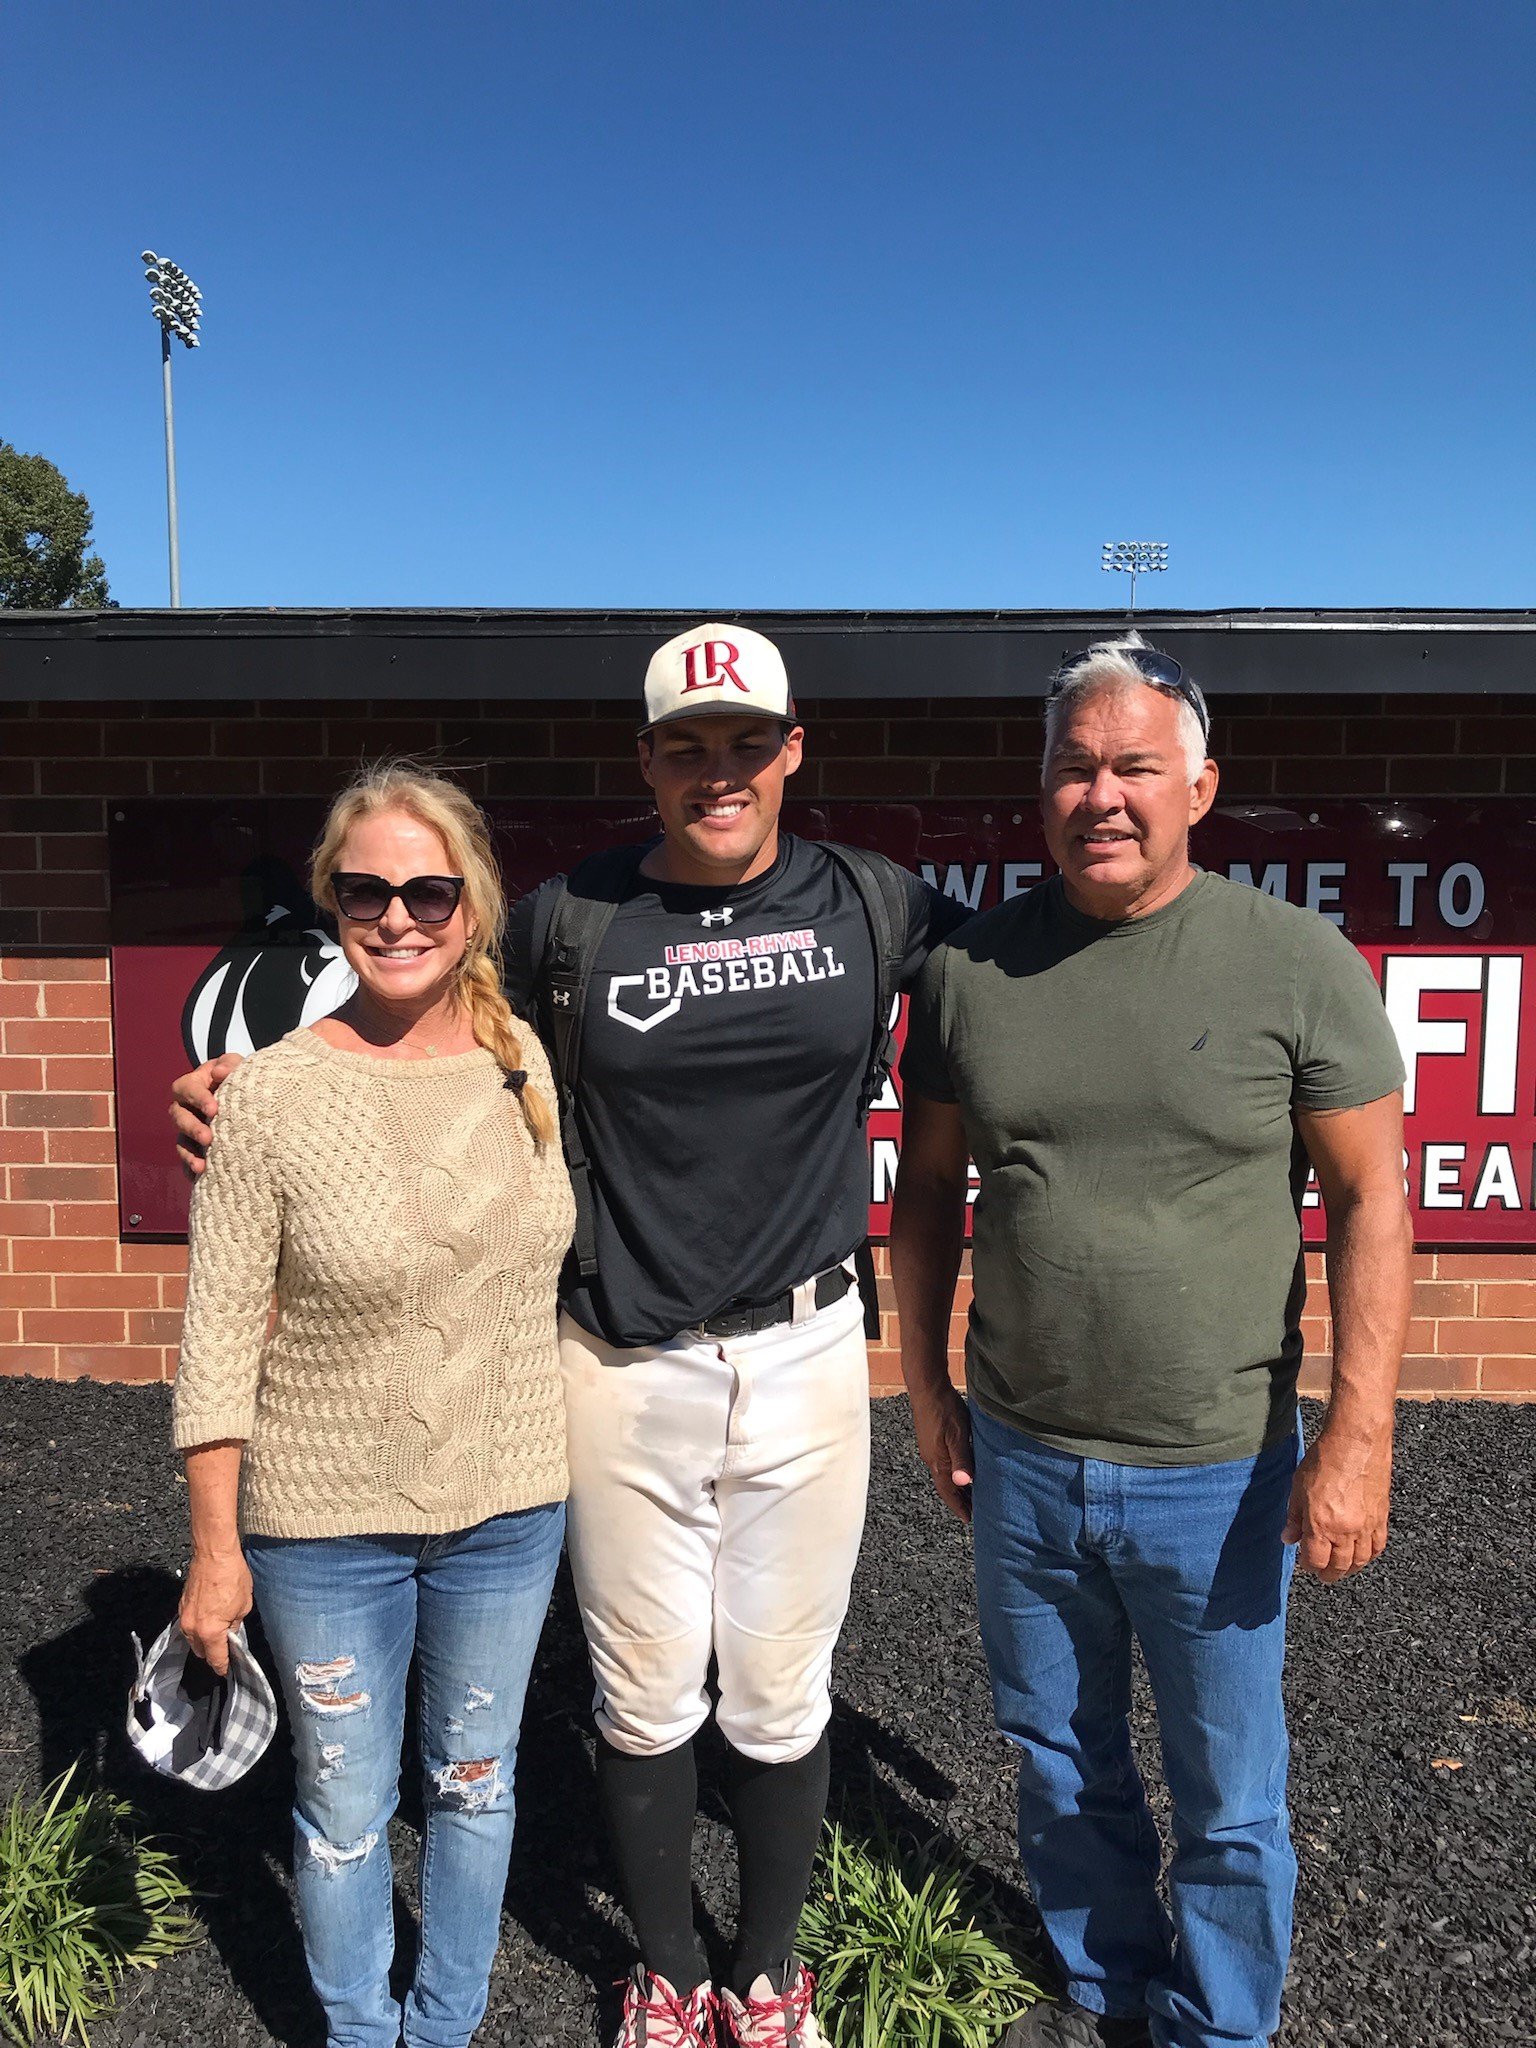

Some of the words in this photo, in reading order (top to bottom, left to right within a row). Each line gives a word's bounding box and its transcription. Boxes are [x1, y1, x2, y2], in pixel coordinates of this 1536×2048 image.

[680, 640, 750, 694] LR
[1387, 861, 1485, 928] TO
[646, 946, 846, 1000] BASEBALL
[664, 928, 818, 966] LENOIR-RHYNE
